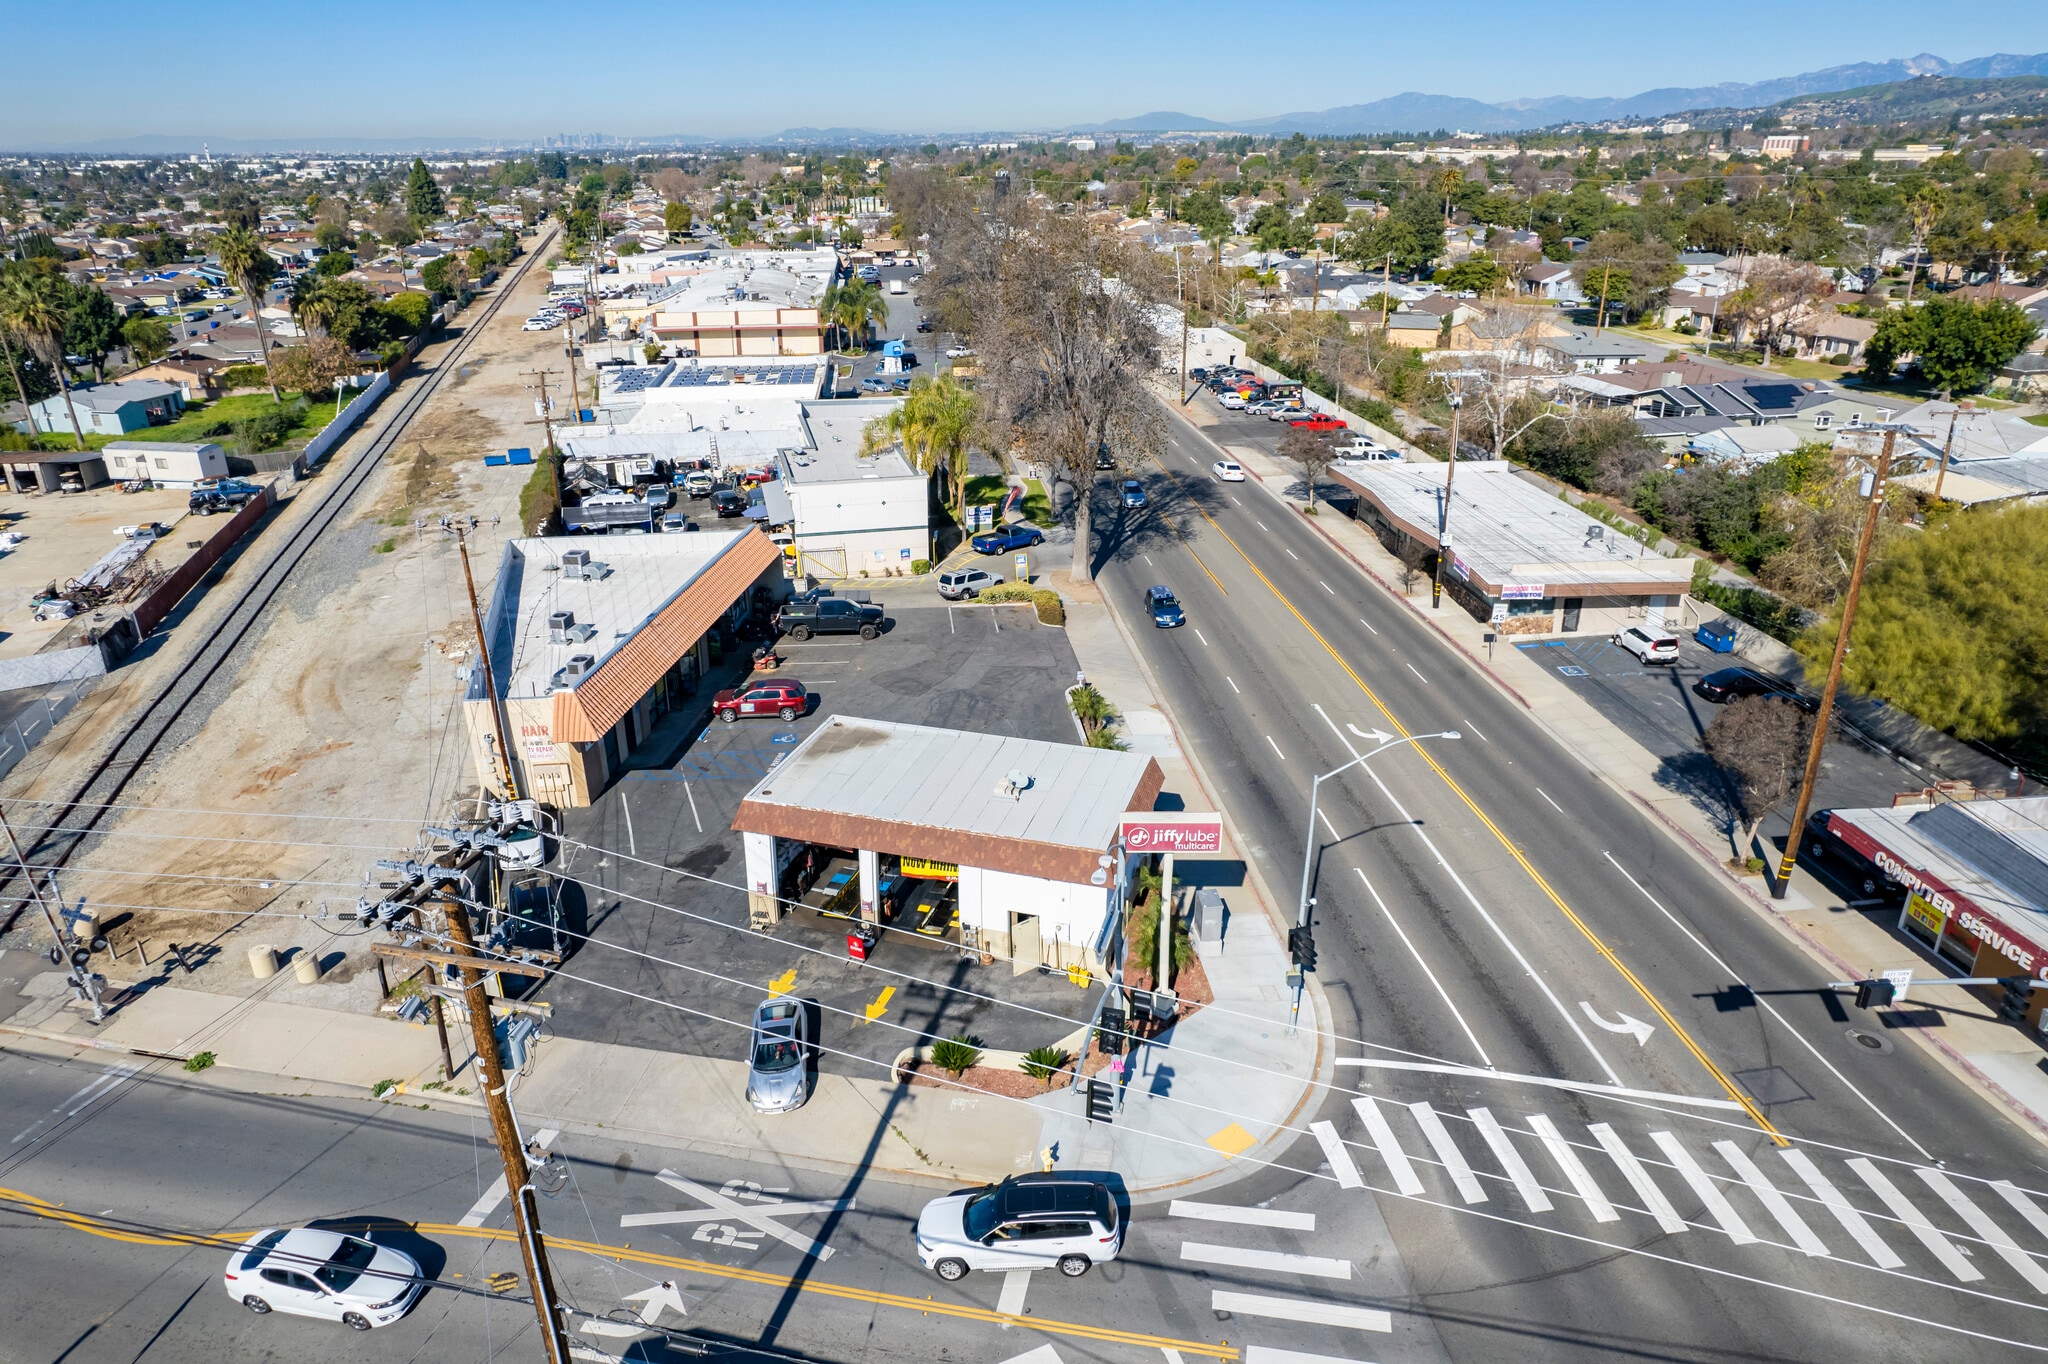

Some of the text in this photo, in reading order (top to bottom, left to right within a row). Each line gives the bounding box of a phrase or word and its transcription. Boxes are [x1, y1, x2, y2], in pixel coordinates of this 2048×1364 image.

[521, 725, 549, 737] HAIR
[1152, 829, 1215, 847] jiffy lube
[1175, 841, 1215, 850] multicare
[903, 856, 959, 872] NOW HIRIN
[1874, 851, 2035, 971] COMPUTER SERVICE
